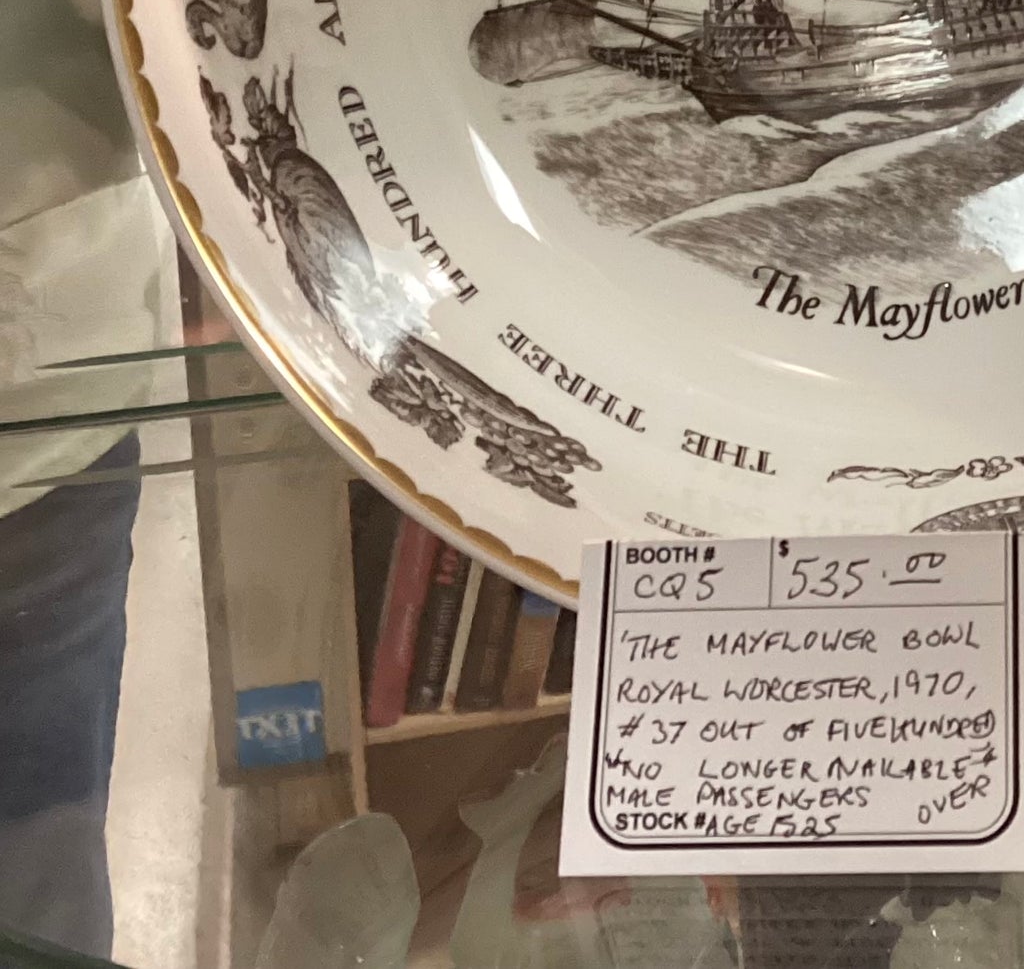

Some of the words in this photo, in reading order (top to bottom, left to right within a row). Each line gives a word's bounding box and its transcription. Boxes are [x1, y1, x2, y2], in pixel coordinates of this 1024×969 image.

[337, 84, 480, 306] HUNDRED
[752, 265, 821, 320] The
[497, 323, 647, 434] THREE
[680, 428, 777, 476] THE
[707, 629, 878, 656] MAYFLOWER
[902, 621, 980, 650] BOWL
[617, 677, 708, 704] ROYAL
[700, 720, 766, 742] OUT
[783, 719, 814, 742] OF
[699, 758, 819, 782] LONGER
[606, 785, 675, 808] MALE
[696, 781, 870, 810] PASSENGERS
[918, 775, 990, 824] OVER
[705, 814, 761, 836] AGE
